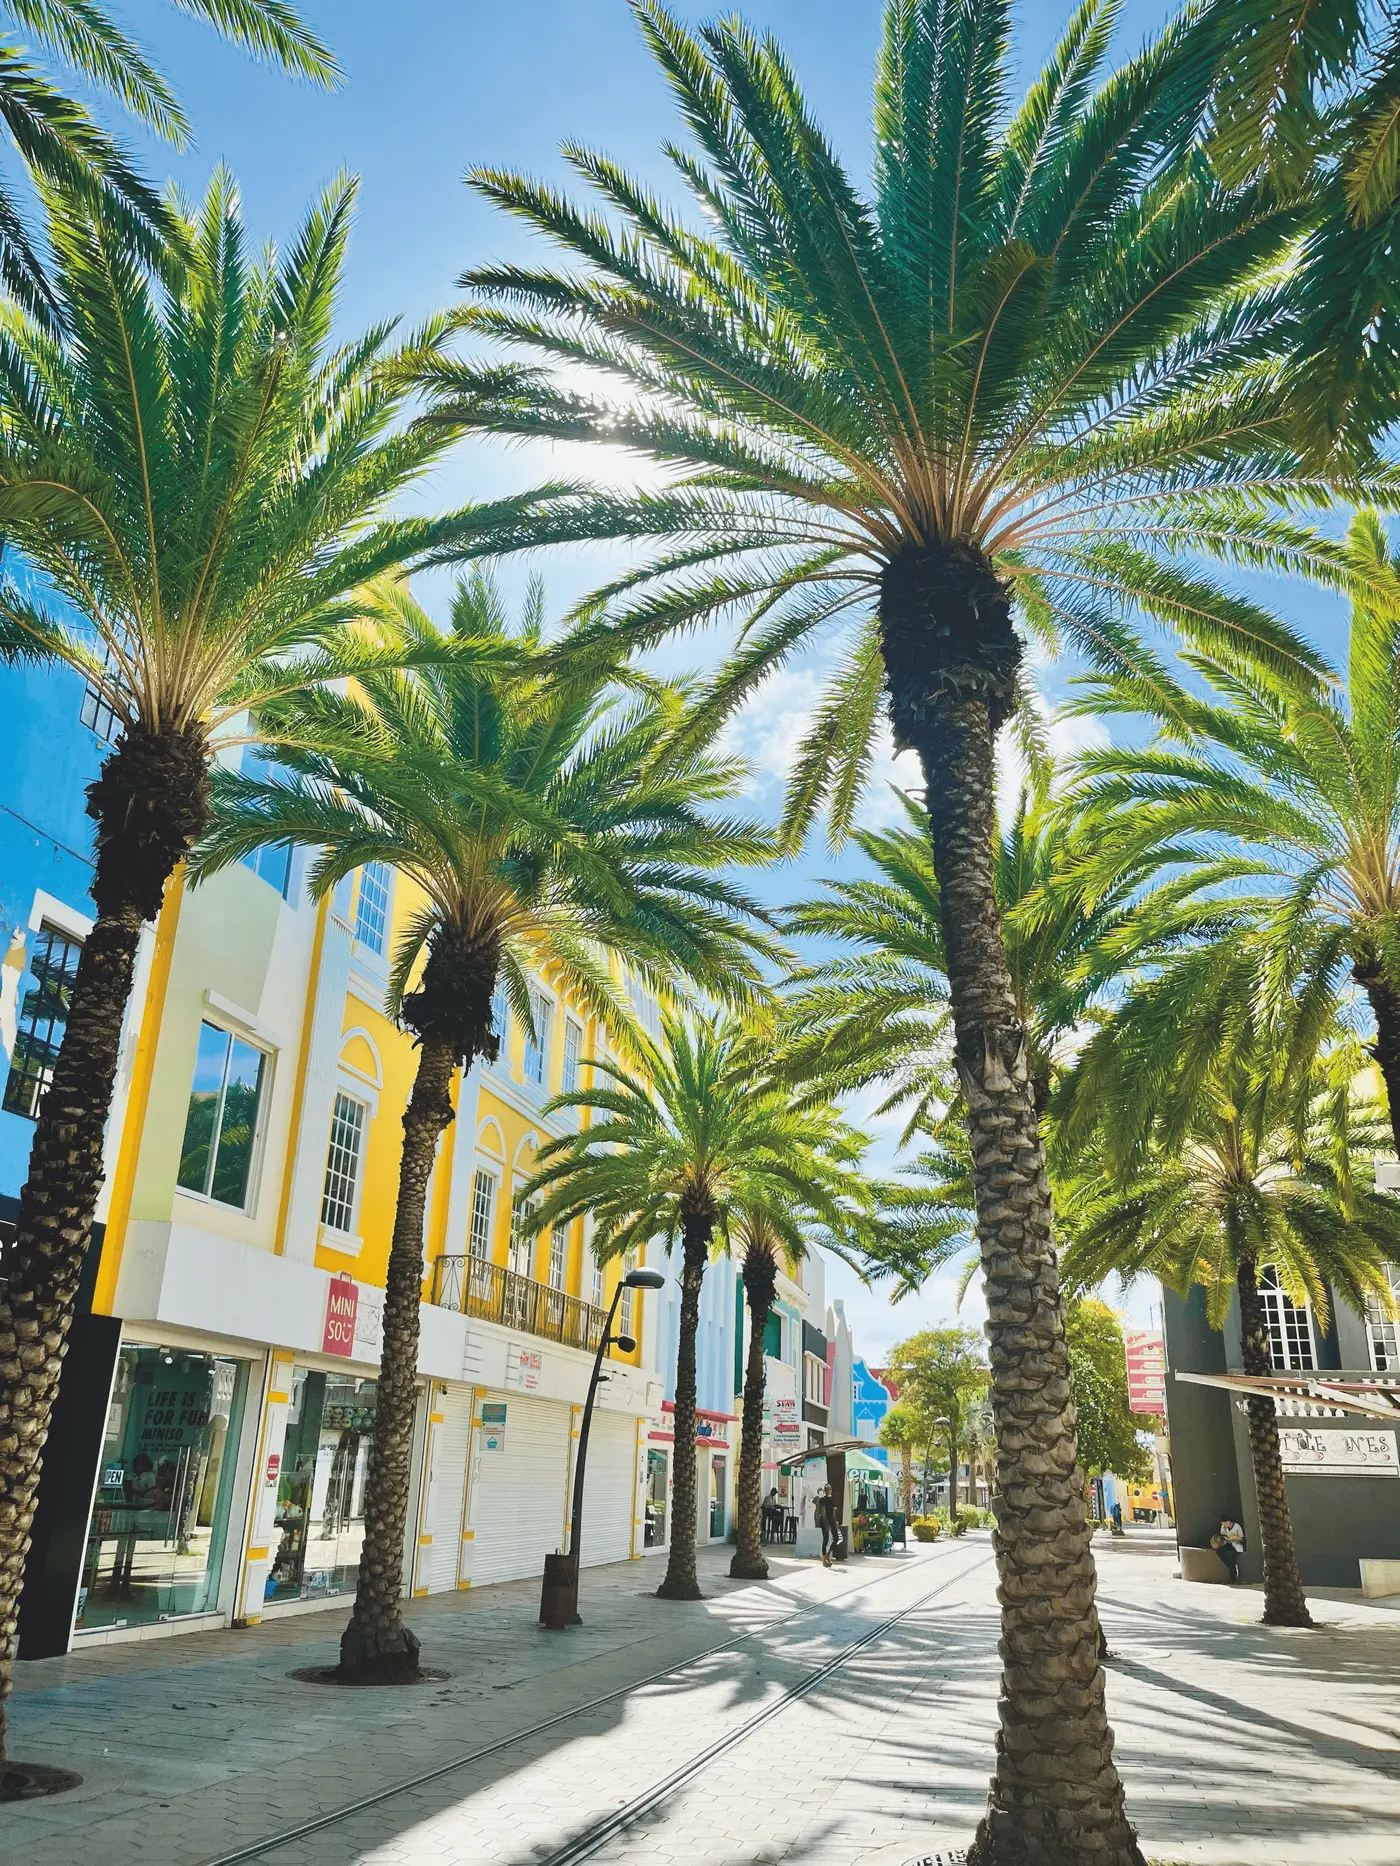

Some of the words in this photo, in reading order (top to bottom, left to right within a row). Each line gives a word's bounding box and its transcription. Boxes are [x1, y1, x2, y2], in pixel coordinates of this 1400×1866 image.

[330, 1294, 355, 1318] MINI
[147, 1391, 178, 1408] LIFE
[181, 1392, 197, 1408] IS
[143, 1409, 175, 1426] FOR
[178, 1410, 210, 1426] FUN
[141, 1428, 184, 1440] MINISO
[1280, 1433, 1327, 1452] TTLE
[105, 1471, 122, 1484] PEN
